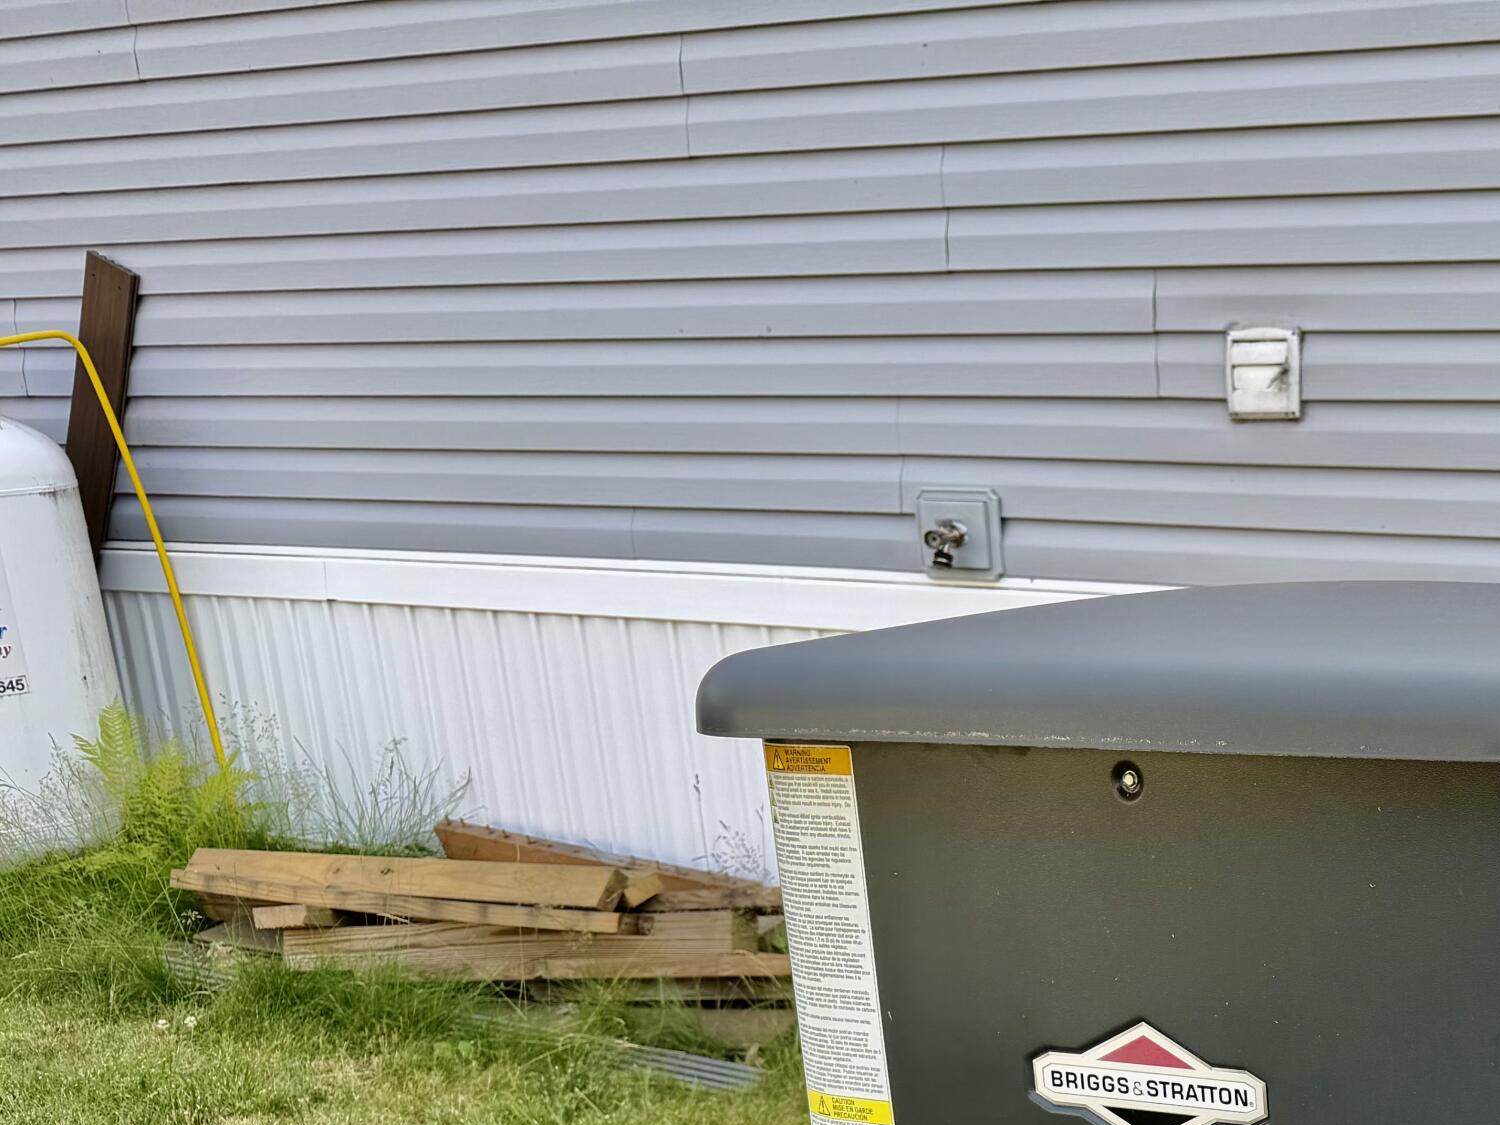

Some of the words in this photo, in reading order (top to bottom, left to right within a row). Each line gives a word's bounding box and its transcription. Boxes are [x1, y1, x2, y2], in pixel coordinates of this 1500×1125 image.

[1051, 1070, 1130, 1094] BRIGGS
[1146, 1080, 1249, 1107] STRATTON
[831, 1097, 855, 1106] CAUTION
